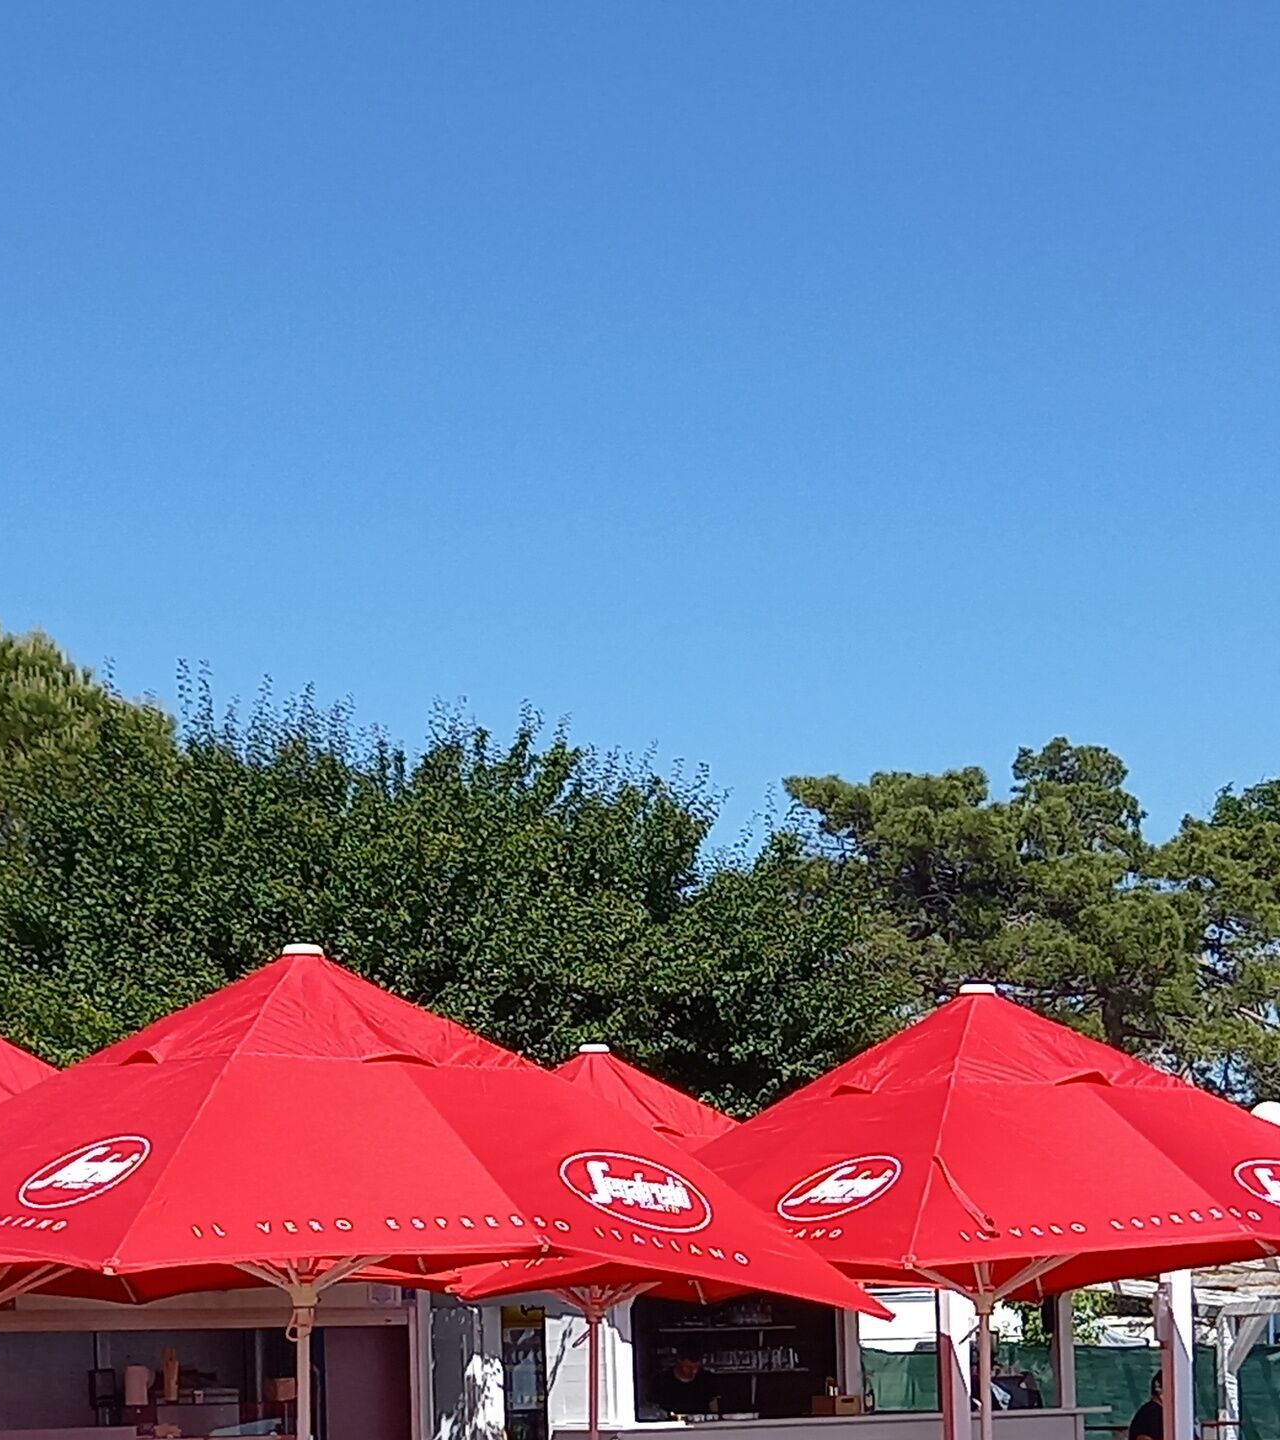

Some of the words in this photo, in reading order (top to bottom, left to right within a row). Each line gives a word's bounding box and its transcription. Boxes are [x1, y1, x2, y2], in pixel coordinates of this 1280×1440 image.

[192, 1222, 226, 1238] IL
[256, 1217, 353, 1234] VERO
[384, 1214, 570, 1233] ESPRESSO
[594, 1226, 749, 1265] ITALIANO
